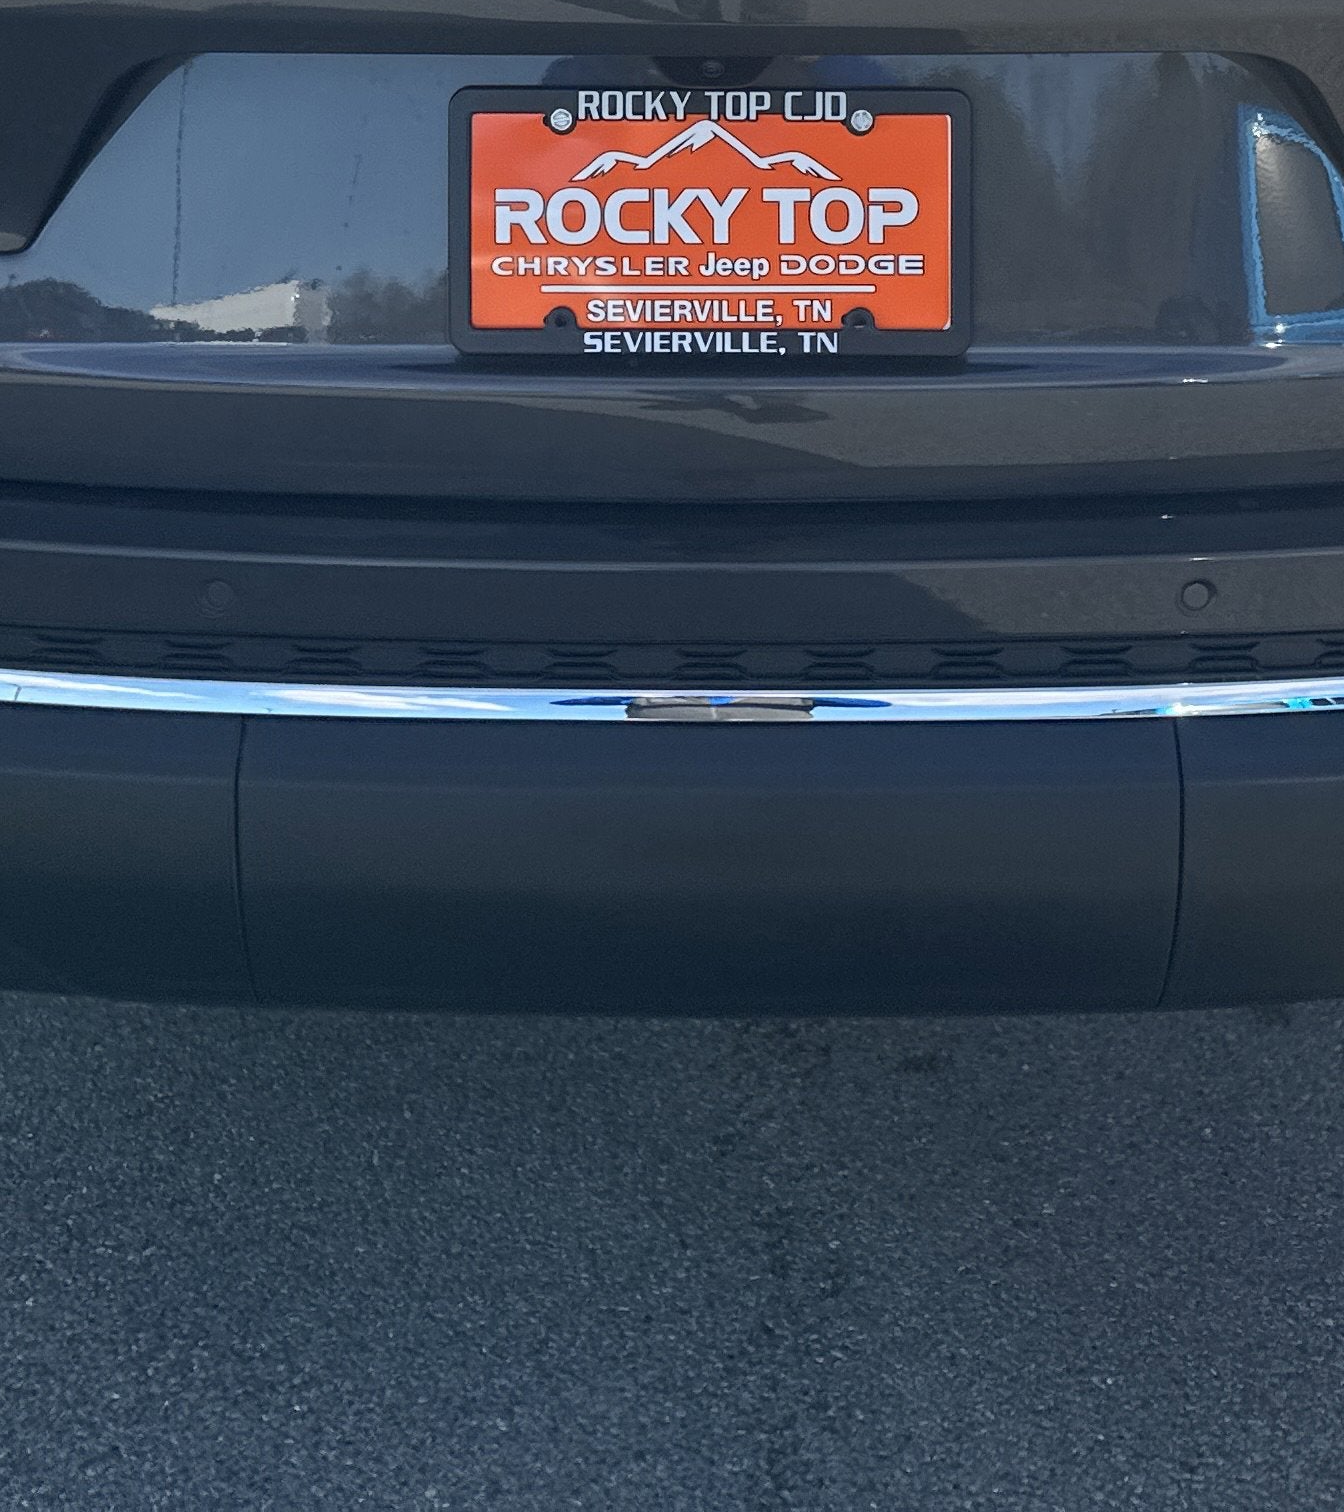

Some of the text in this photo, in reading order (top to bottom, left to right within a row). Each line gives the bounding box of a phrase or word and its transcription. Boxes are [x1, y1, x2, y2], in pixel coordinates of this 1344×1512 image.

[577, 90, 848, 122] ROCKY TOP CJD
[493, 187, 920, 245] ROCKY TOP
[490, 252, 926, 280] CHRYSLER Jeep DODGE
[586, 299, 833, 327] SEVIERVILLE, TN
[582, 331, 839, 356] SEVIERVILLE, TN
